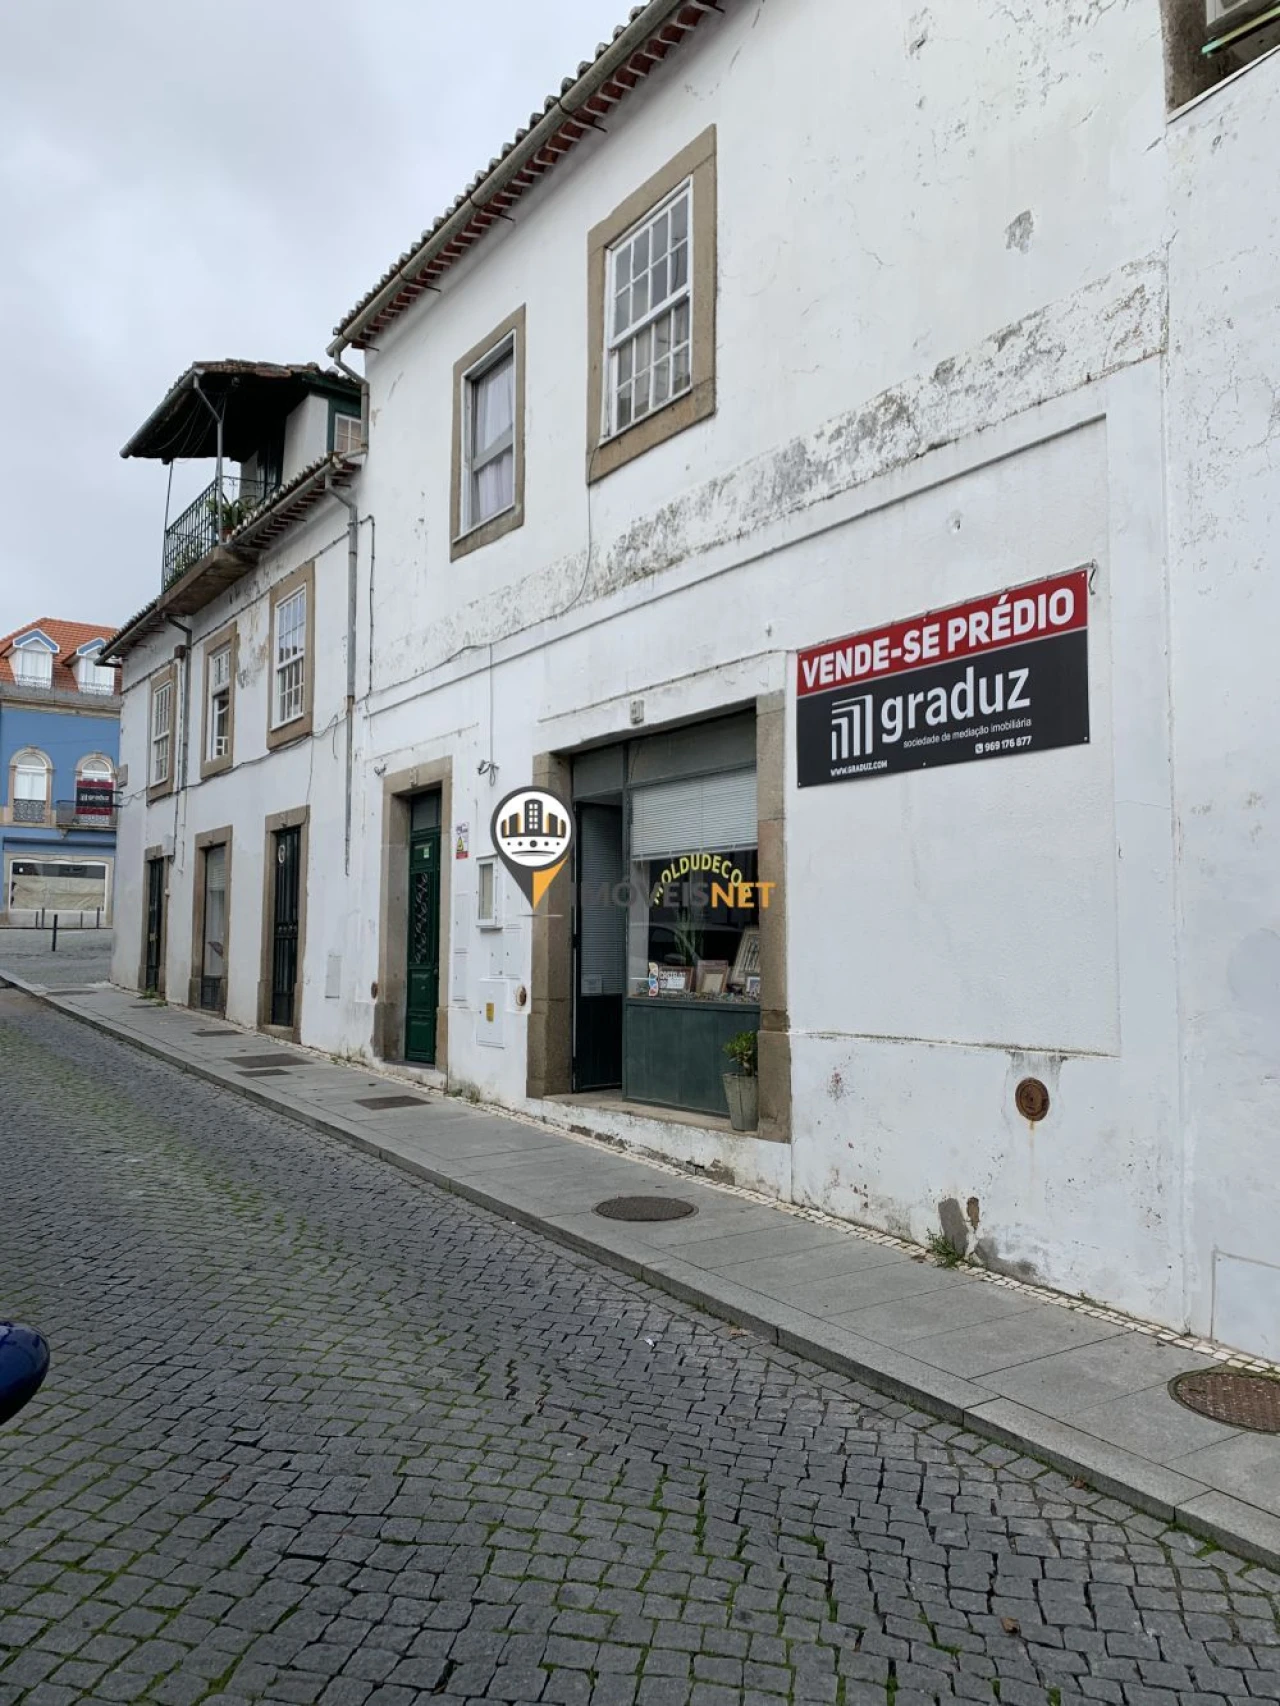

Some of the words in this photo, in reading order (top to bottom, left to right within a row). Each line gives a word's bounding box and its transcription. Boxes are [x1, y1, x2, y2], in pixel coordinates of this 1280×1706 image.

[802, 622, 940, 689] VENDE-SE
[947, 588, 1075, 653] PRÉDIO
[881, 666, 1031, 743] graduz
[903, 734, 940, 749] sociedade
[941, 732, 951, 742] de
[952, 725, 989, 738] mediação
[990, 717, 1032, 733] imobiliária
